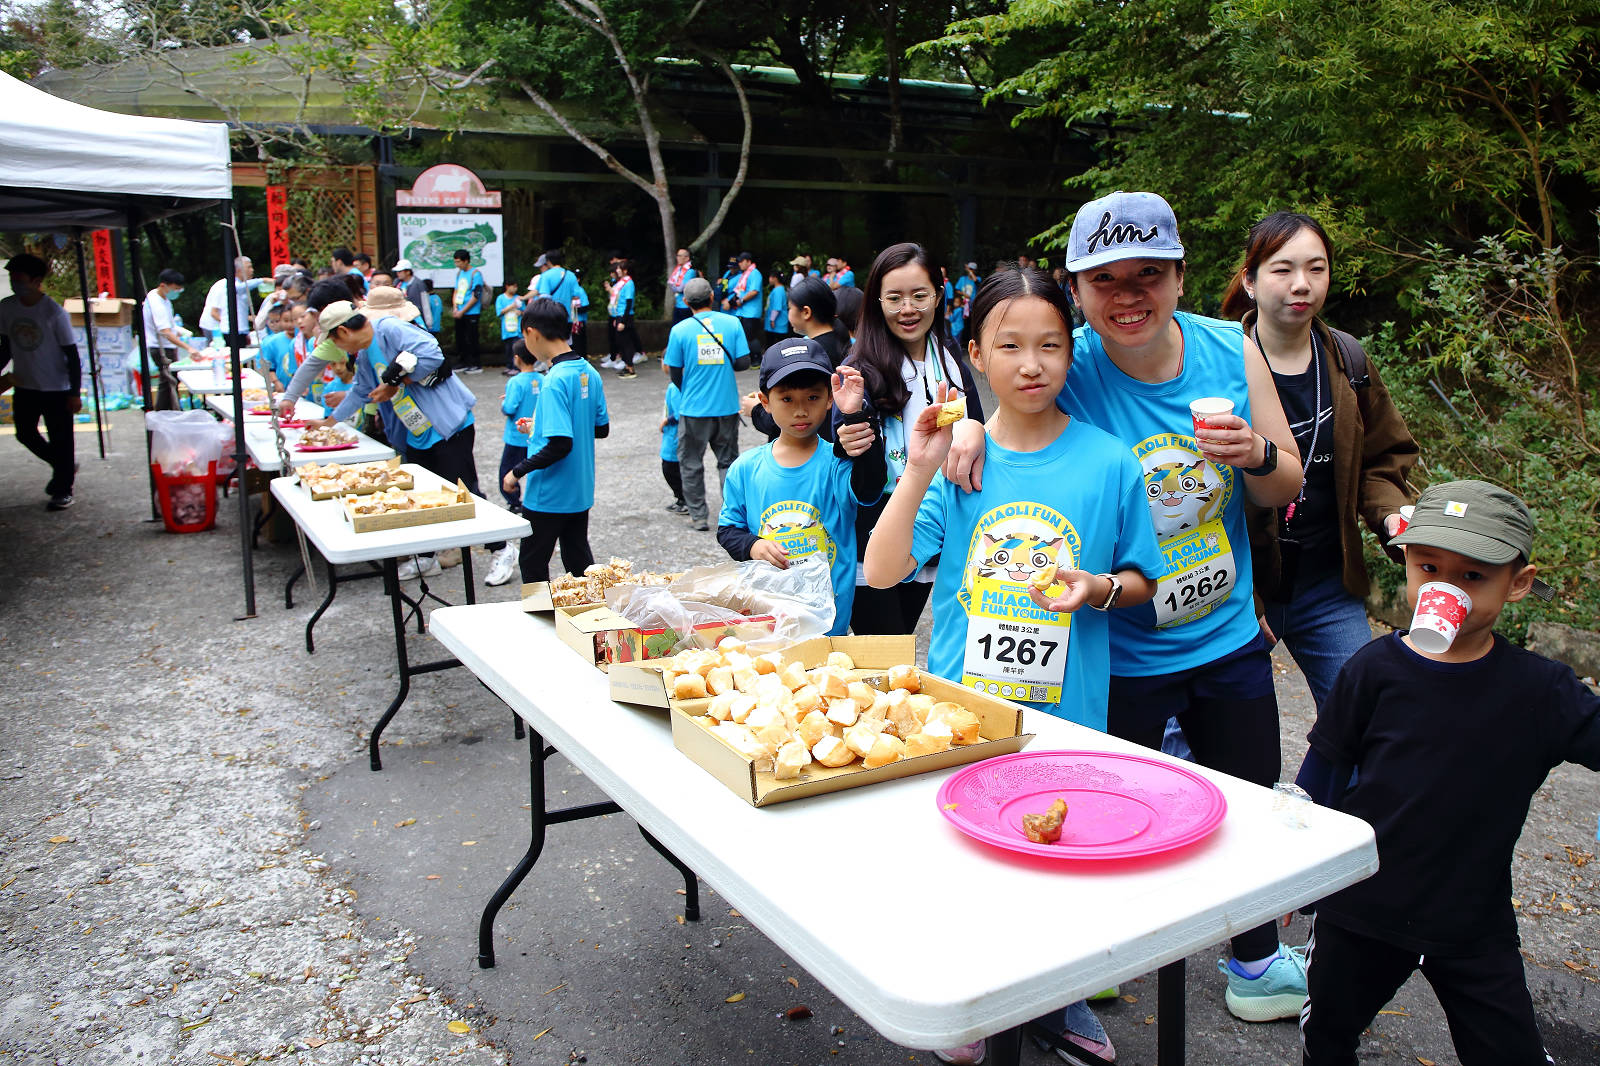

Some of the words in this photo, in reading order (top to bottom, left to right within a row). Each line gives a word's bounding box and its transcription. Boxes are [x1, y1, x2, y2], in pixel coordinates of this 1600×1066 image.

[400, 216, 427, 227] Map
[701, 347, 721, 356] 0617
[1137, 437, 1168, 458] AOLI
[1171, 436, 1198, 453] FUN
[1215, 463, 1232, 489] UNG
[761, 503, 793, 523] MIAOLI
[796, 504, 815, 517] FUN
[980, 505, 1029, 531] MIAOLI
[1032, 507, 1061, 528] FUN
[1062, 524, 1080, 568] YOUN
[1163, 538, 1208, 565] IAOLI
[1180, 544, 1221, 568] YOUNG
[1165, 569, 1229, 611] 1262
[981, 603, 1009, 617] FUN
[1011, 608, 1060, 622] YOUNG
[978, 633, 1059, 667] 1267
